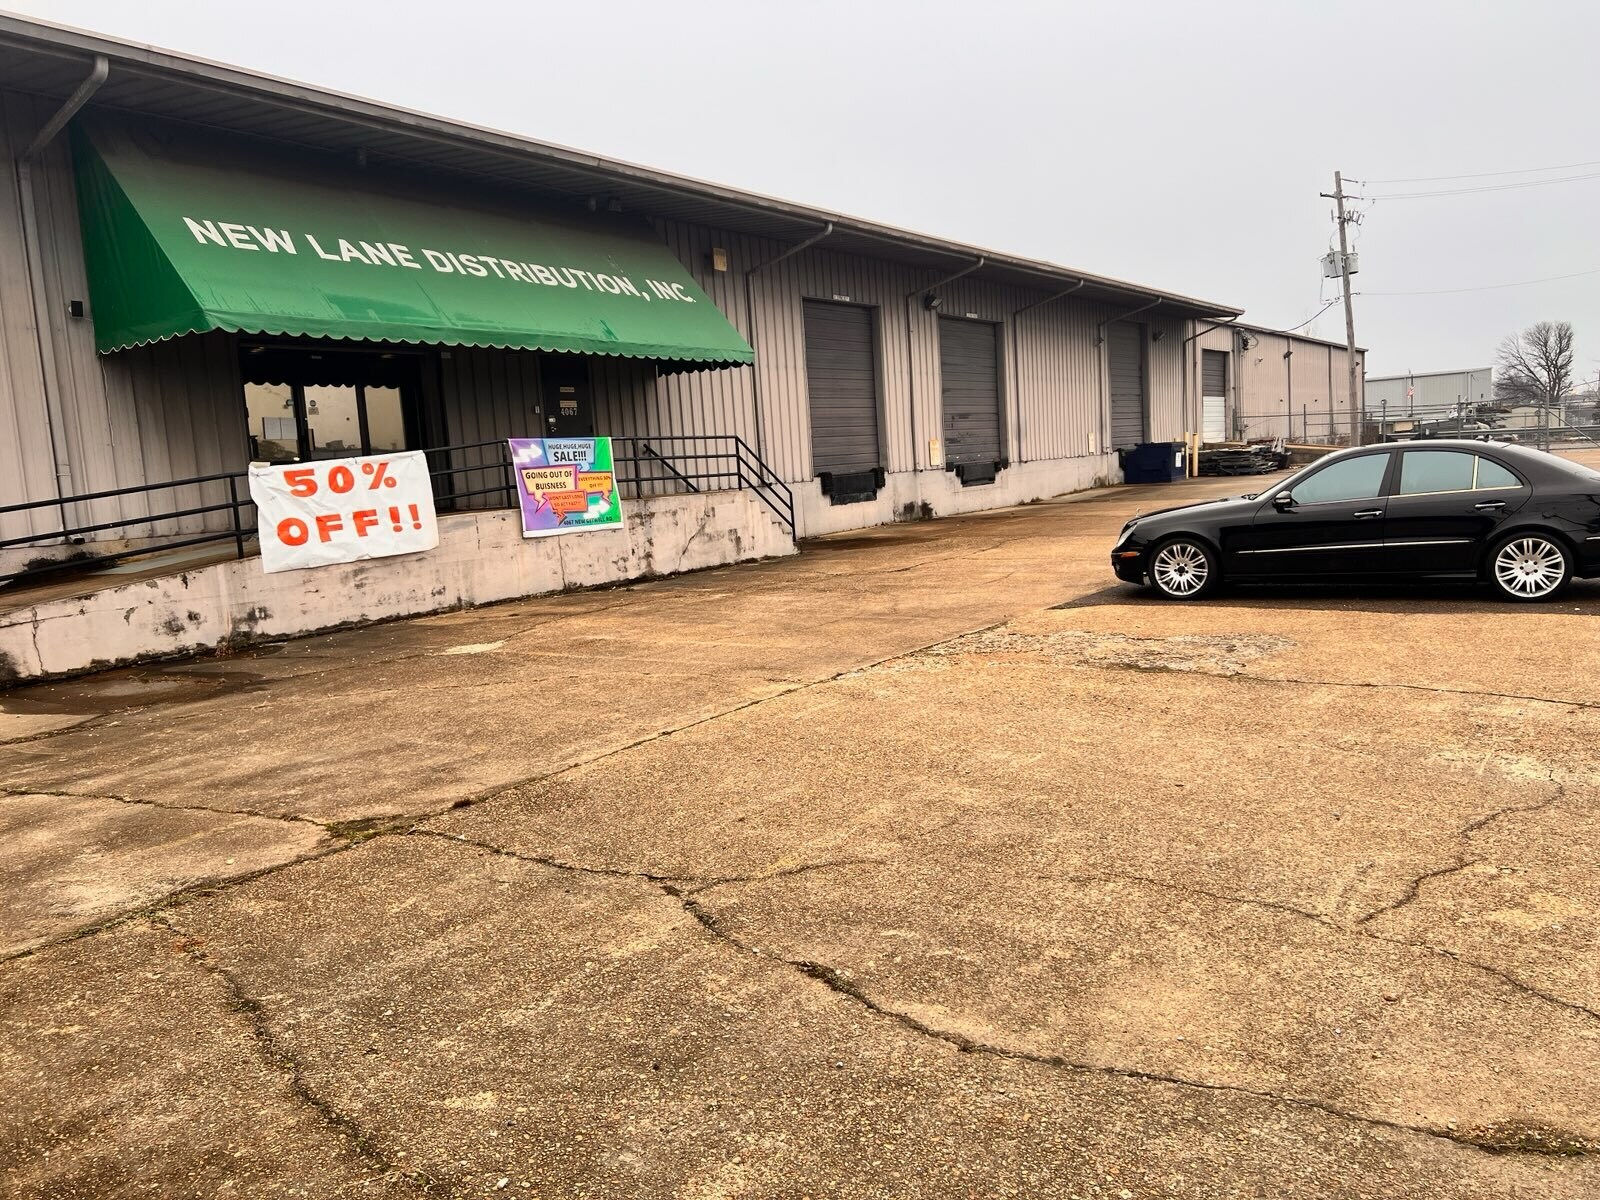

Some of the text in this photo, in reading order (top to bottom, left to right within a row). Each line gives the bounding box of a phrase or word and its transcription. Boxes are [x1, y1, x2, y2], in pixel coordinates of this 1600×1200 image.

[182, 216, 697, 303] NEW LANE DISTRIBUTION, INC.
[560, 407, 577, 416] 4067
[553, 450, 587, 462] SALE!!!
[283, 462, 397, 498] 50%
[525, 471, 548, 479] GOING
[535, 481, 567, 490] BUISNESS
[277, 504, 422, 546] OFF!!
